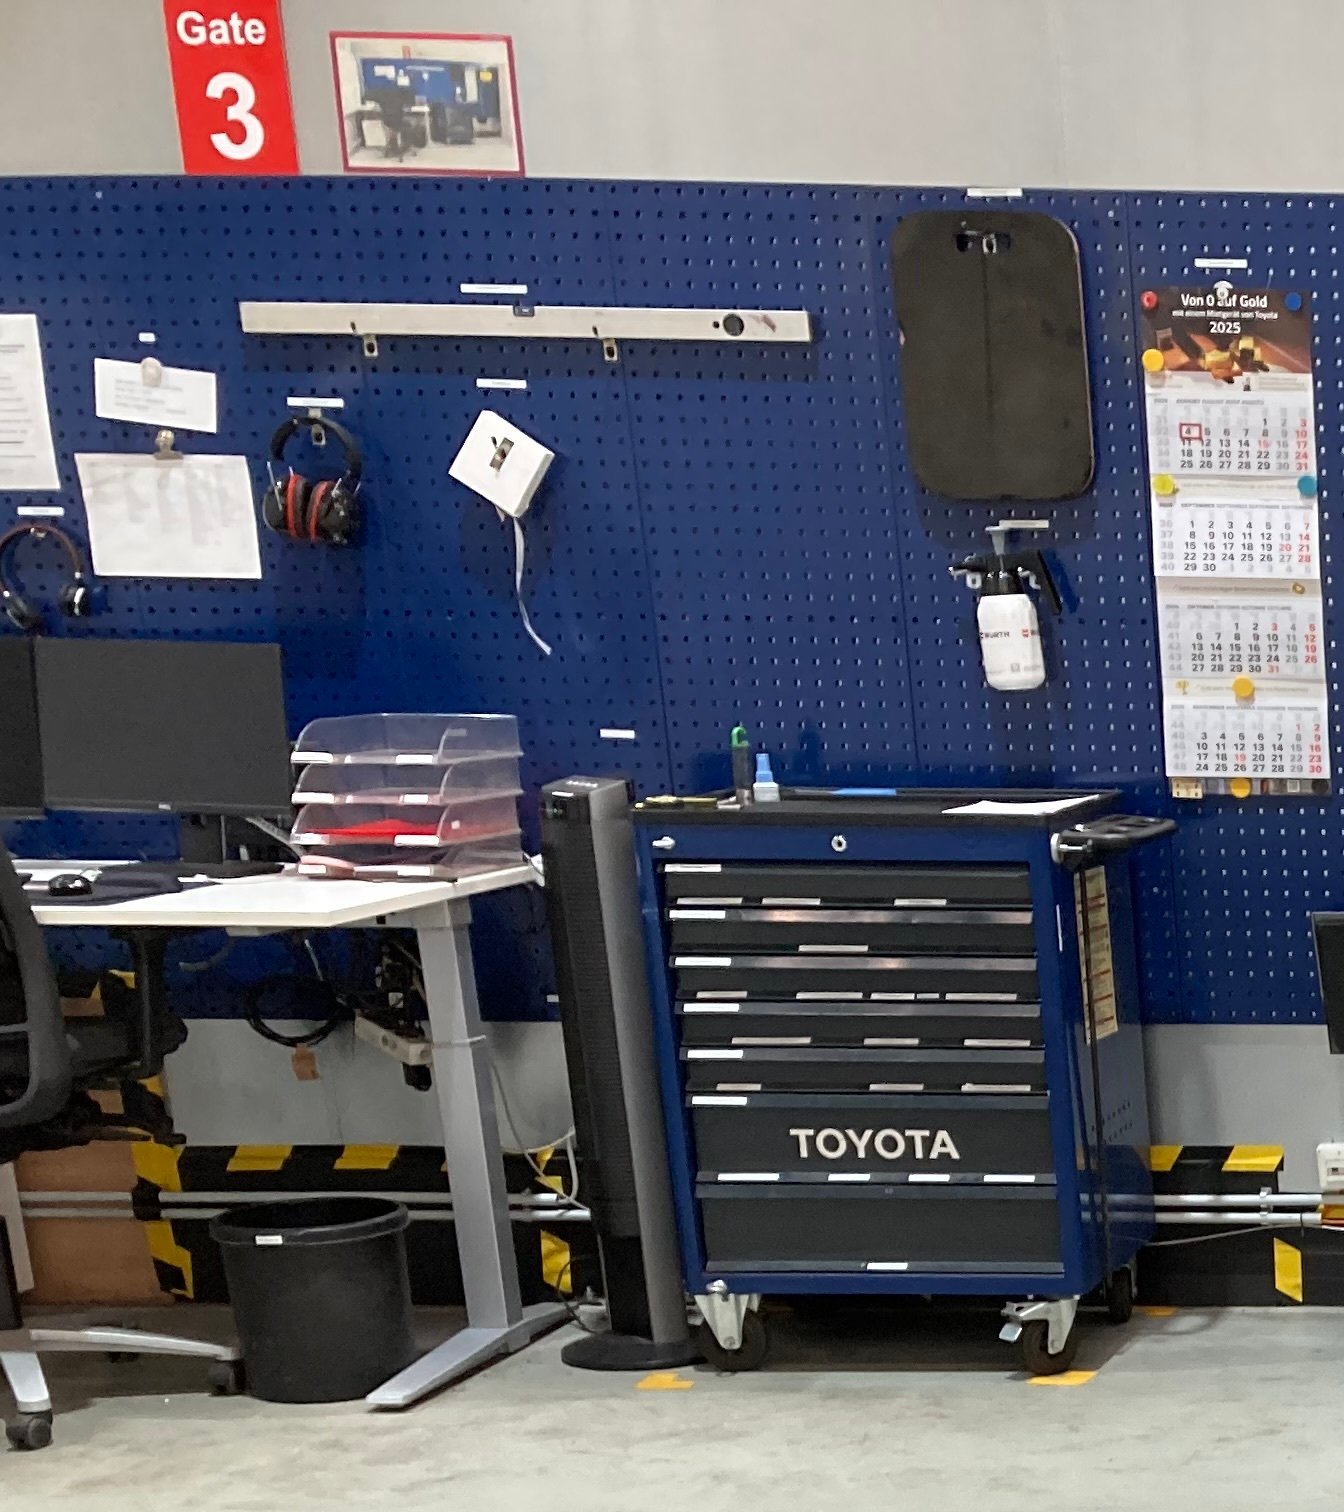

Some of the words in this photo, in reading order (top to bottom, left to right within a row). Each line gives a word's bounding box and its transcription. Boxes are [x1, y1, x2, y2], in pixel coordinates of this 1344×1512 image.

[176, 10, 267, 46] Gate
[206, 71, 265, 160] 3
[1181, 294, 1204, 306] Von
[1217, 294, 1237, 307] auf
[1240, 295, 1268, 308] Gold
[1209, 320, 1241, 334] 2025
[1239, 440, 1250, 448] 14
[1181, 449, 1193, 457] 18
[1219, 450, 1231, 458] 20
[1276, 451, 1288, 459] 23
[1181, 460, 1193, 468] 25
[1200, 460, 1212, 468] 26
[1219, 461, 1231, 469] 27
[1238, 461, 1251, 469] 28
[1277, 462, 1289, 470] 30
[1297, 462, 1307, 470] 31
[1223, 532, 1234, 540] 10
[1242, 532, 1252, 540] 11
[1242, 543, 1253, 551] 18
[1261, 543, 1272, 551] 19
[1299, 544, 1310, 552] 21
[1203, 553, 1215, 561] 23
[1222, 553, 1234, 561] 24
[1260, 554, 1272, 562] 26
[1280, 554, 1291, 562] 27
[1185, 563, 1197, 571] 29
[1192, 643, 1203, 651] 13
[1268, 644, 1278, 652] 17
[1305, 645, 1316, 653] 19
[1211, 654, 1222, 662] 21
[1229, 654, 1241, 662] 22
[1286, 655, 1298, 663] 25
[1192, 664, 1204, 672] 27
[1211, 664, 1223, 672] 28
[1216, 743, 1225, 751] 11
[1234, 743, 1245, 751] 12
[1253, 754, 1265, 762] 20
[1272, 754, 1283, 762] 21
[1309, 755, 1321, 763] 23
[1215, 764, 1227, 772] 25
[1309, 765, 1322, 773] 30
[789, 1127, 961, 1160] TOYOTA
